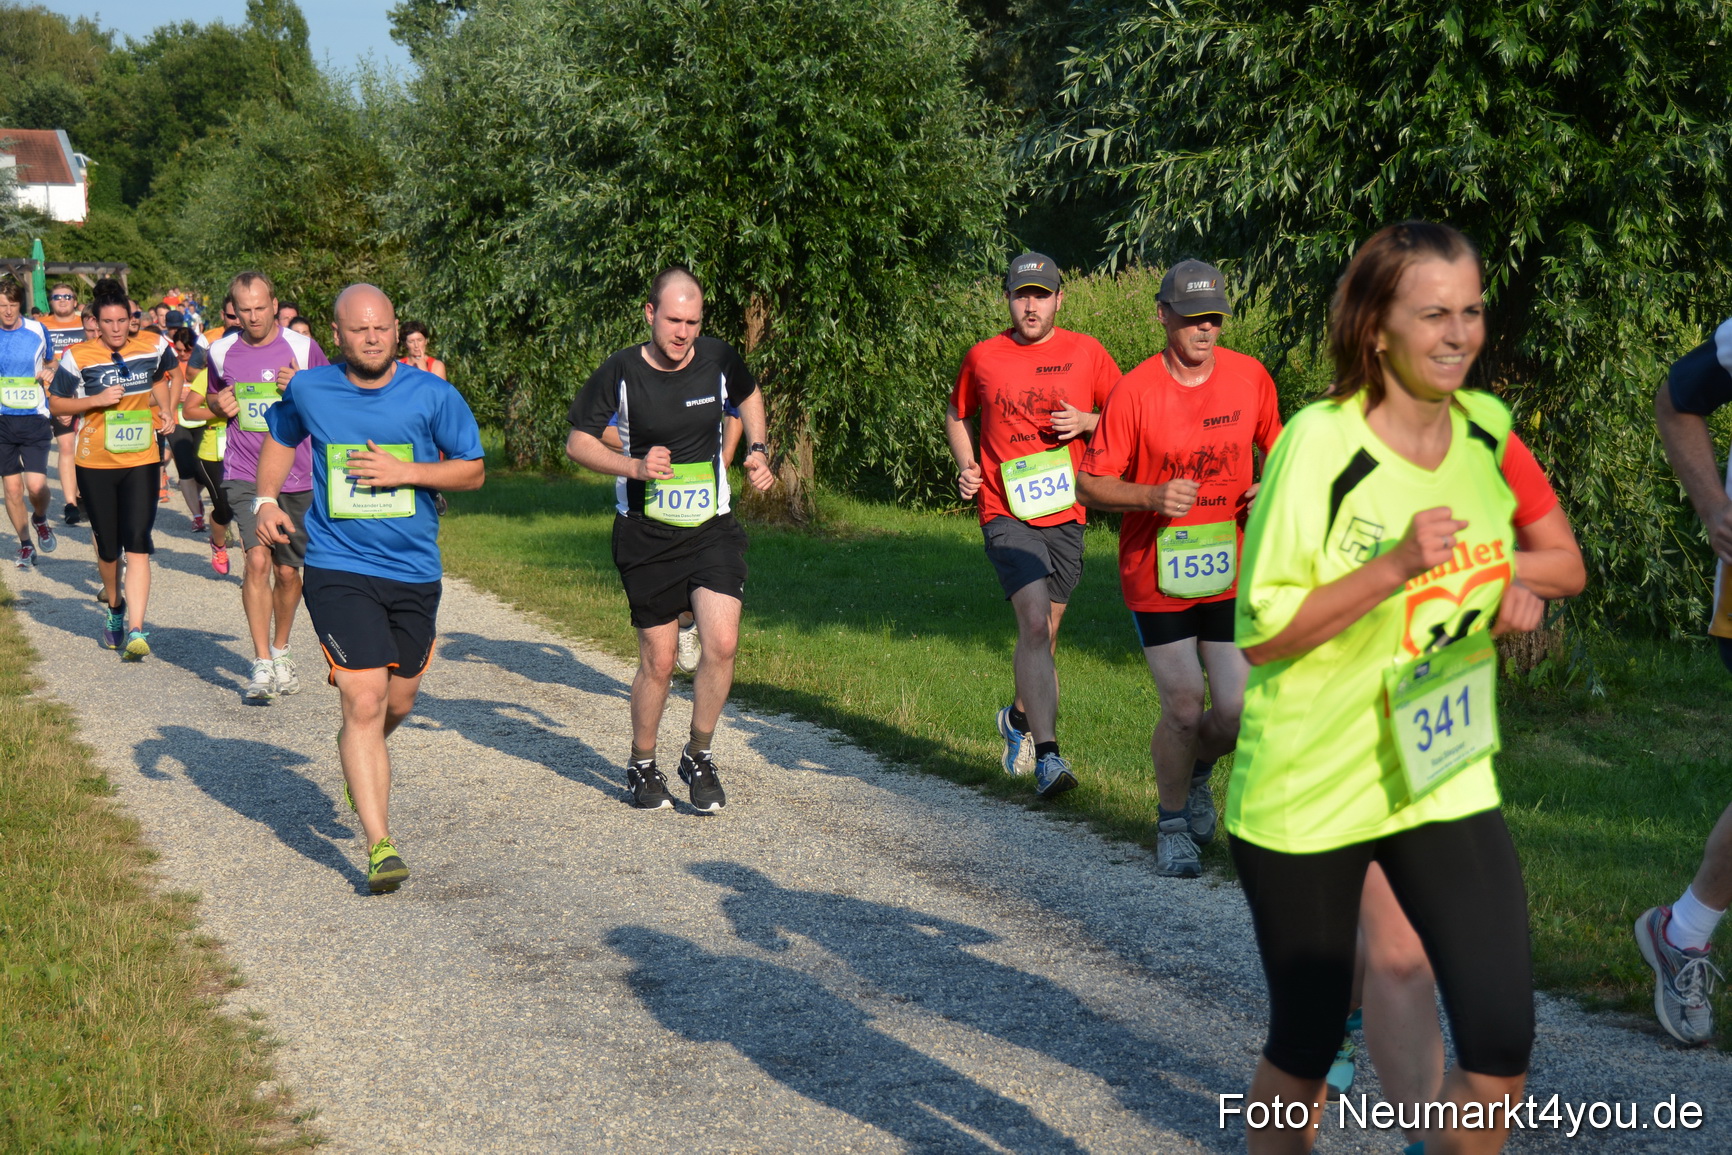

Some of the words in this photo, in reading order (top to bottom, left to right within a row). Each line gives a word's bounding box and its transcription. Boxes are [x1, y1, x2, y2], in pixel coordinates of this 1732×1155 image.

[1018, 262, 1037, 270] swn
[1186, 280, 1210, 290] swn
[51, 334, 83, 344] Fischer
[1036, 365, 1061, 374] swn
[5, 390, 35, 400] 1125
[248, 402, 269, 418] 50
[1203, 415, 1231, 428] swn
[115, 427, 143, 441] 407
[1010, 433, 1036, 443] Alles
[1014, 472, 1070, 503] 1534
[654, 488, 710, 509] 1073
[1196, 495, 1227, 506] läuft
[1168, 551, 1230, 579] 1533
[1413, 684, 1470, 752] 341
